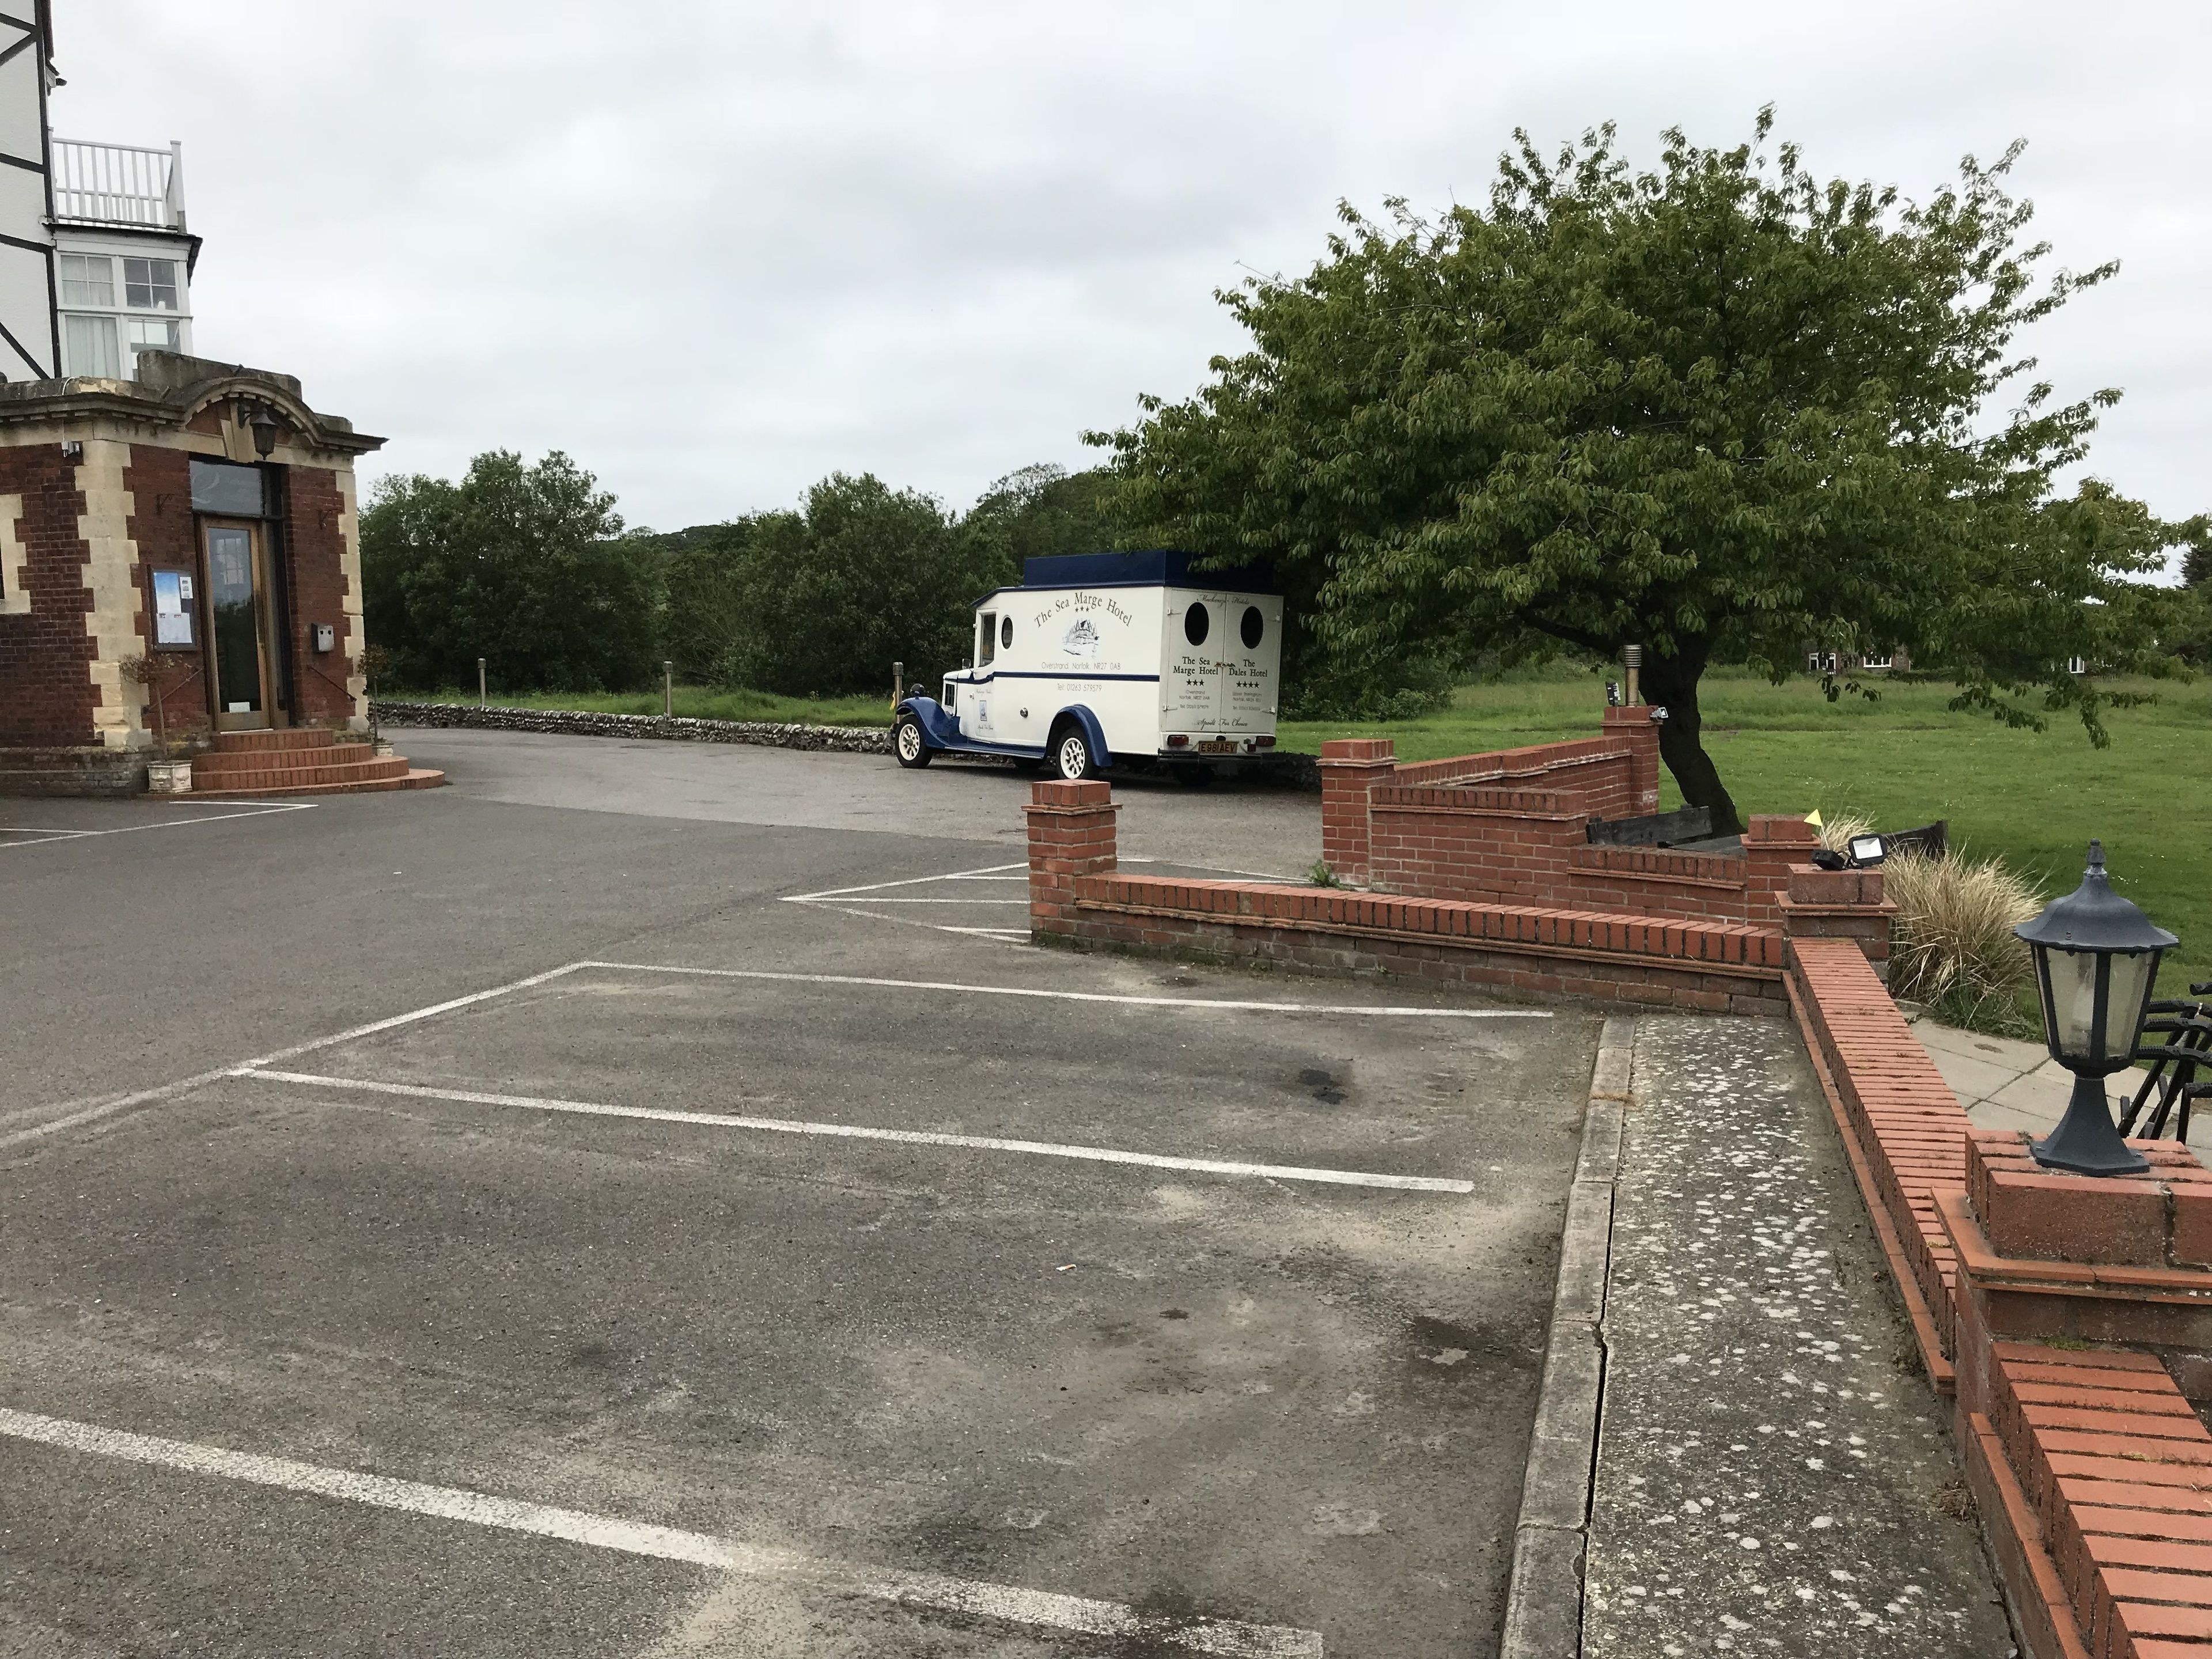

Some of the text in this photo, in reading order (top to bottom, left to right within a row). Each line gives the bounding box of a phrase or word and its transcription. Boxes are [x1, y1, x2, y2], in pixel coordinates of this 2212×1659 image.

[1034, 592, 1132, 628] The Sea Marge Hotel
[1182, 656, 1210, 665] The Sea
[1243, 659, 1255, 667] The
[1173, 665, 1219, 676] Marge Hotel
[1229, 668, 1268, 677] Dales Hotel
